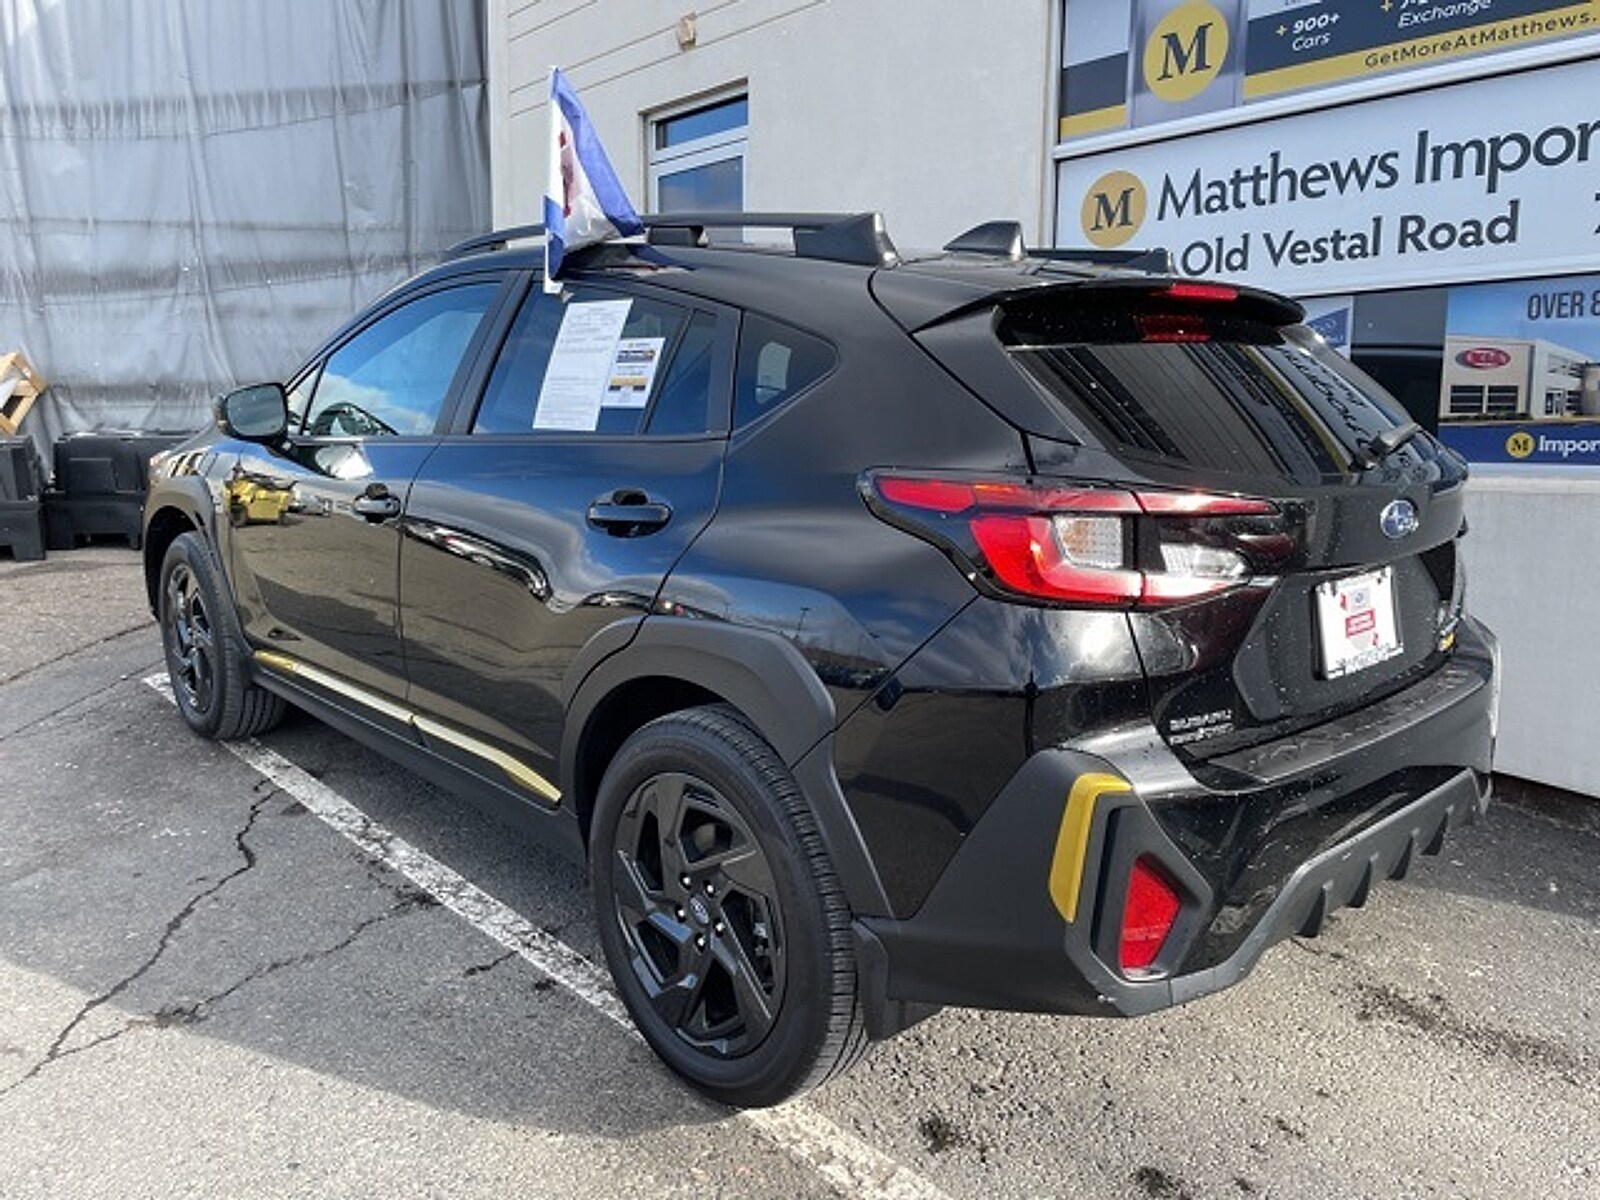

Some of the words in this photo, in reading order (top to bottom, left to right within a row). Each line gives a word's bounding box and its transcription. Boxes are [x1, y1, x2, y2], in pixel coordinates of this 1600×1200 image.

[1292, 12, 1340, 34] 900+
[1292, 32, 1331, 51] Cars
[1156, 23, 1213, 82] M
[1157, 150, 1399, 221] Matthews
[1414, 119, 1600, 194] Impor
[1090, 187, 1135, 231] M
[1181, 232, 1251, 276] Old
[1263, 215, 1383, 268] Vestal
[1397, 198, 1521, 254] Road
[1527, 289, 1584, 320] OVER
